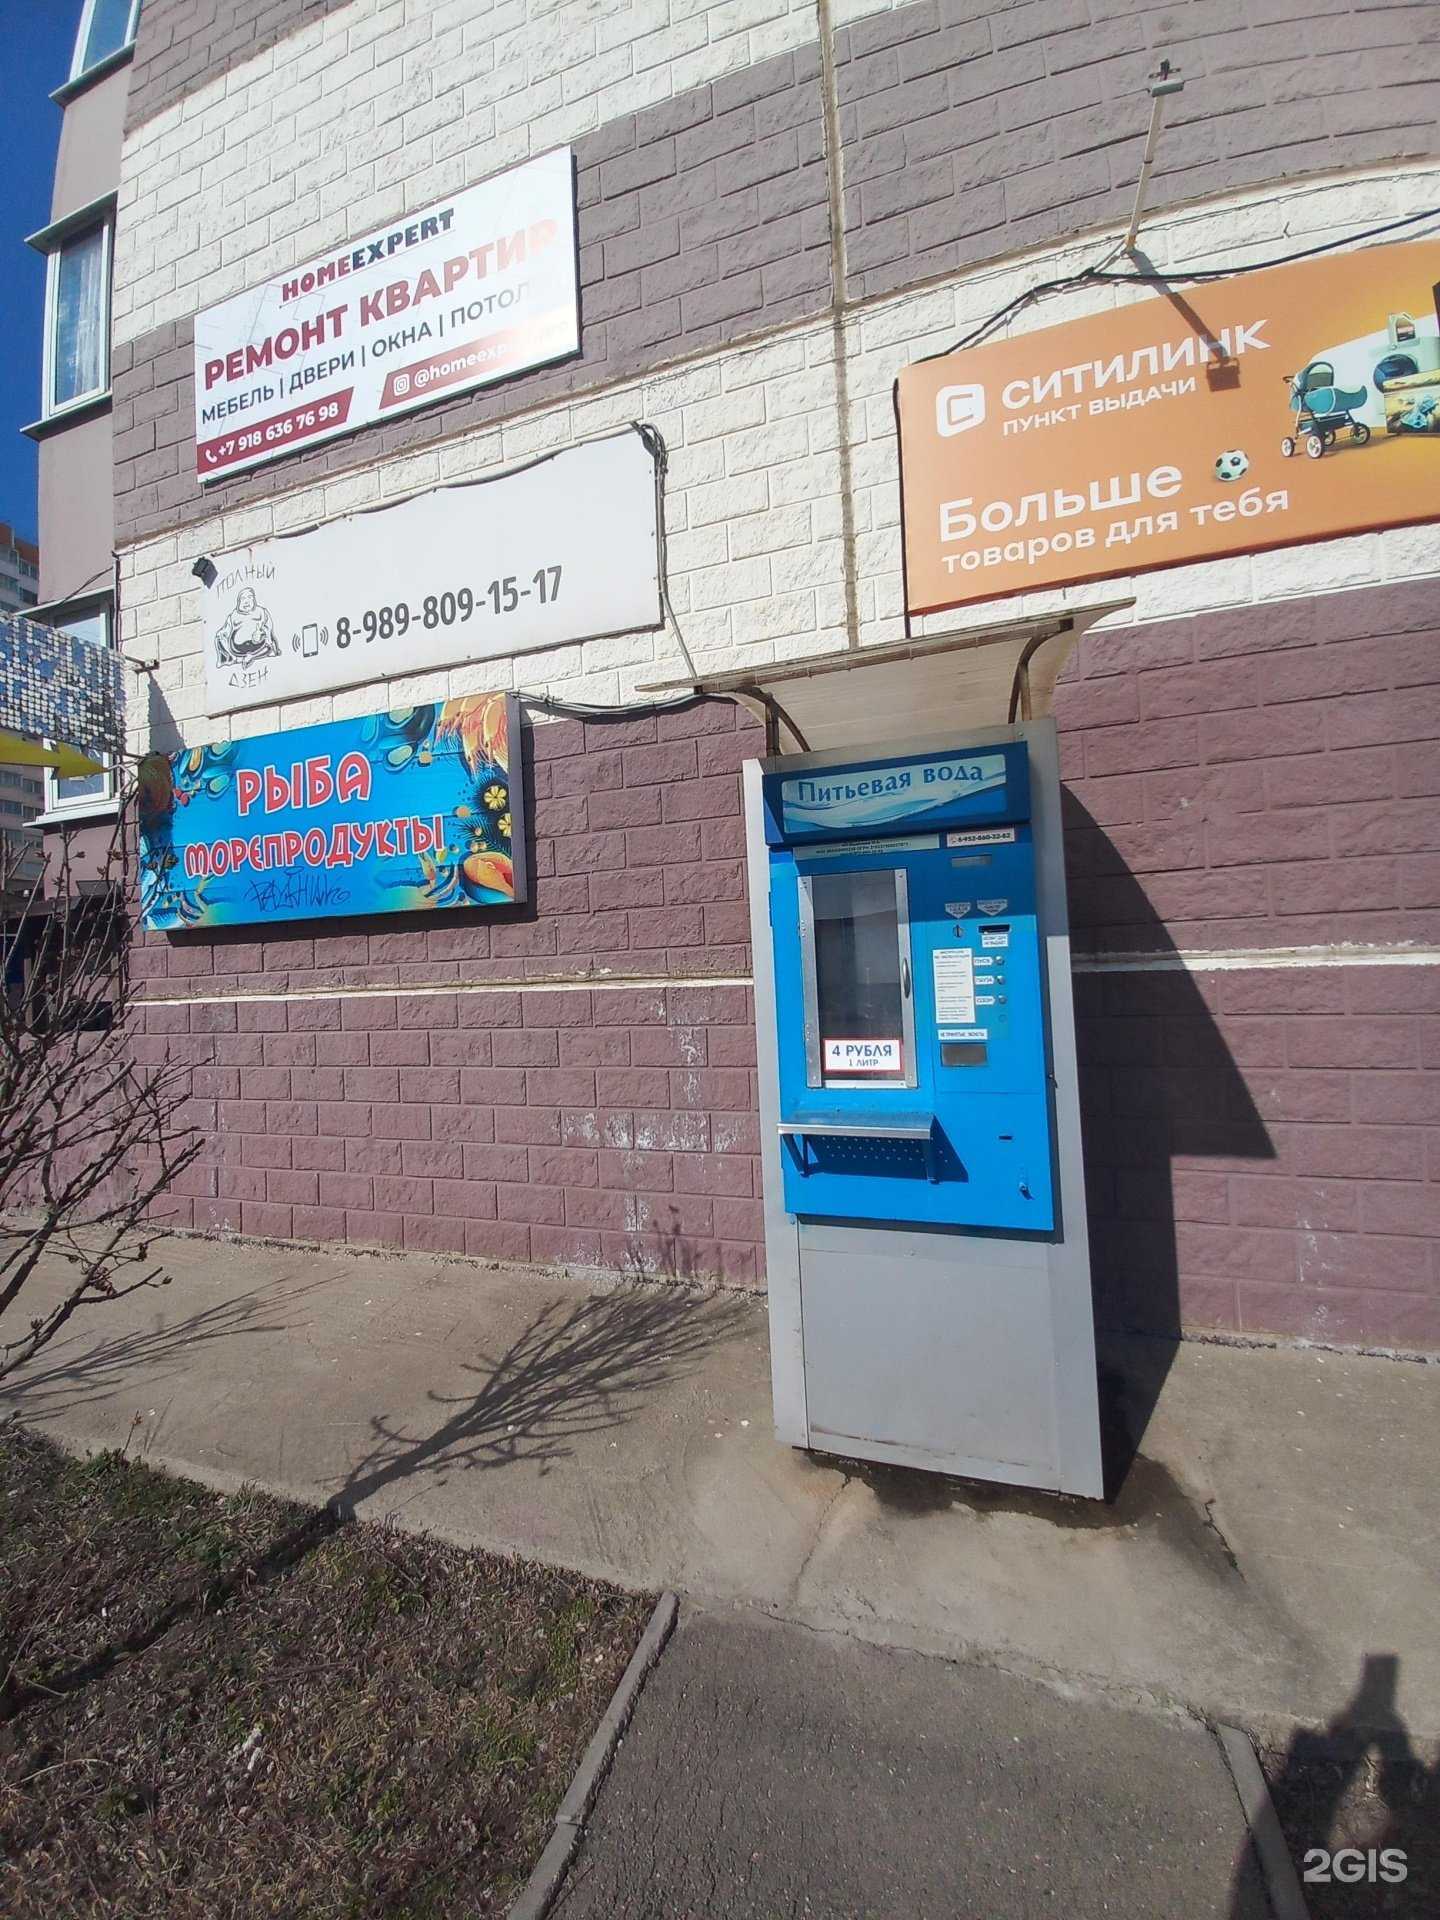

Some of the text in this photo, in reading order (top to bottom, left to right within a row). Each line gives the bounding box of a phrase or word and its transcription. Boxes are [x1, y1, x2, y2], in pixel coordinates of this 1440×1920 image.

[282, 208, 455, 302] HOMEEXPERT
[204, 219, 558, 391] РЕМОНТ КВАРТИР
[202, 281, 532, 425] МЕБЕЛЬ ДВЕРИ ОКНА ПОТОЛ
[414, 342, 508, 389] @homeexp
[1002, 319, 1271, 410] СИТИЛИНК
[218, 402, 340, 457] +7 918 636 76 98
[1002, 377, 1197, 436] ПУНКТ ВЫДАЧИ
[939, 464, 1183, 543] Больше
[941, 486, 1288, 574] товаров для тебя
[335, 565, 563, 650] 8-989-809-15-17
[236, 751, 372, 816] РЫБА
[799, 764, 984, 803] Питьевая вода
[184, 814, 446, 880] МОРЕПРОДУКТЫ
[832, 1044, 892, 1057] 4 РУБЛЯ
[855, 1058, 879, 1067] ЛИТР
